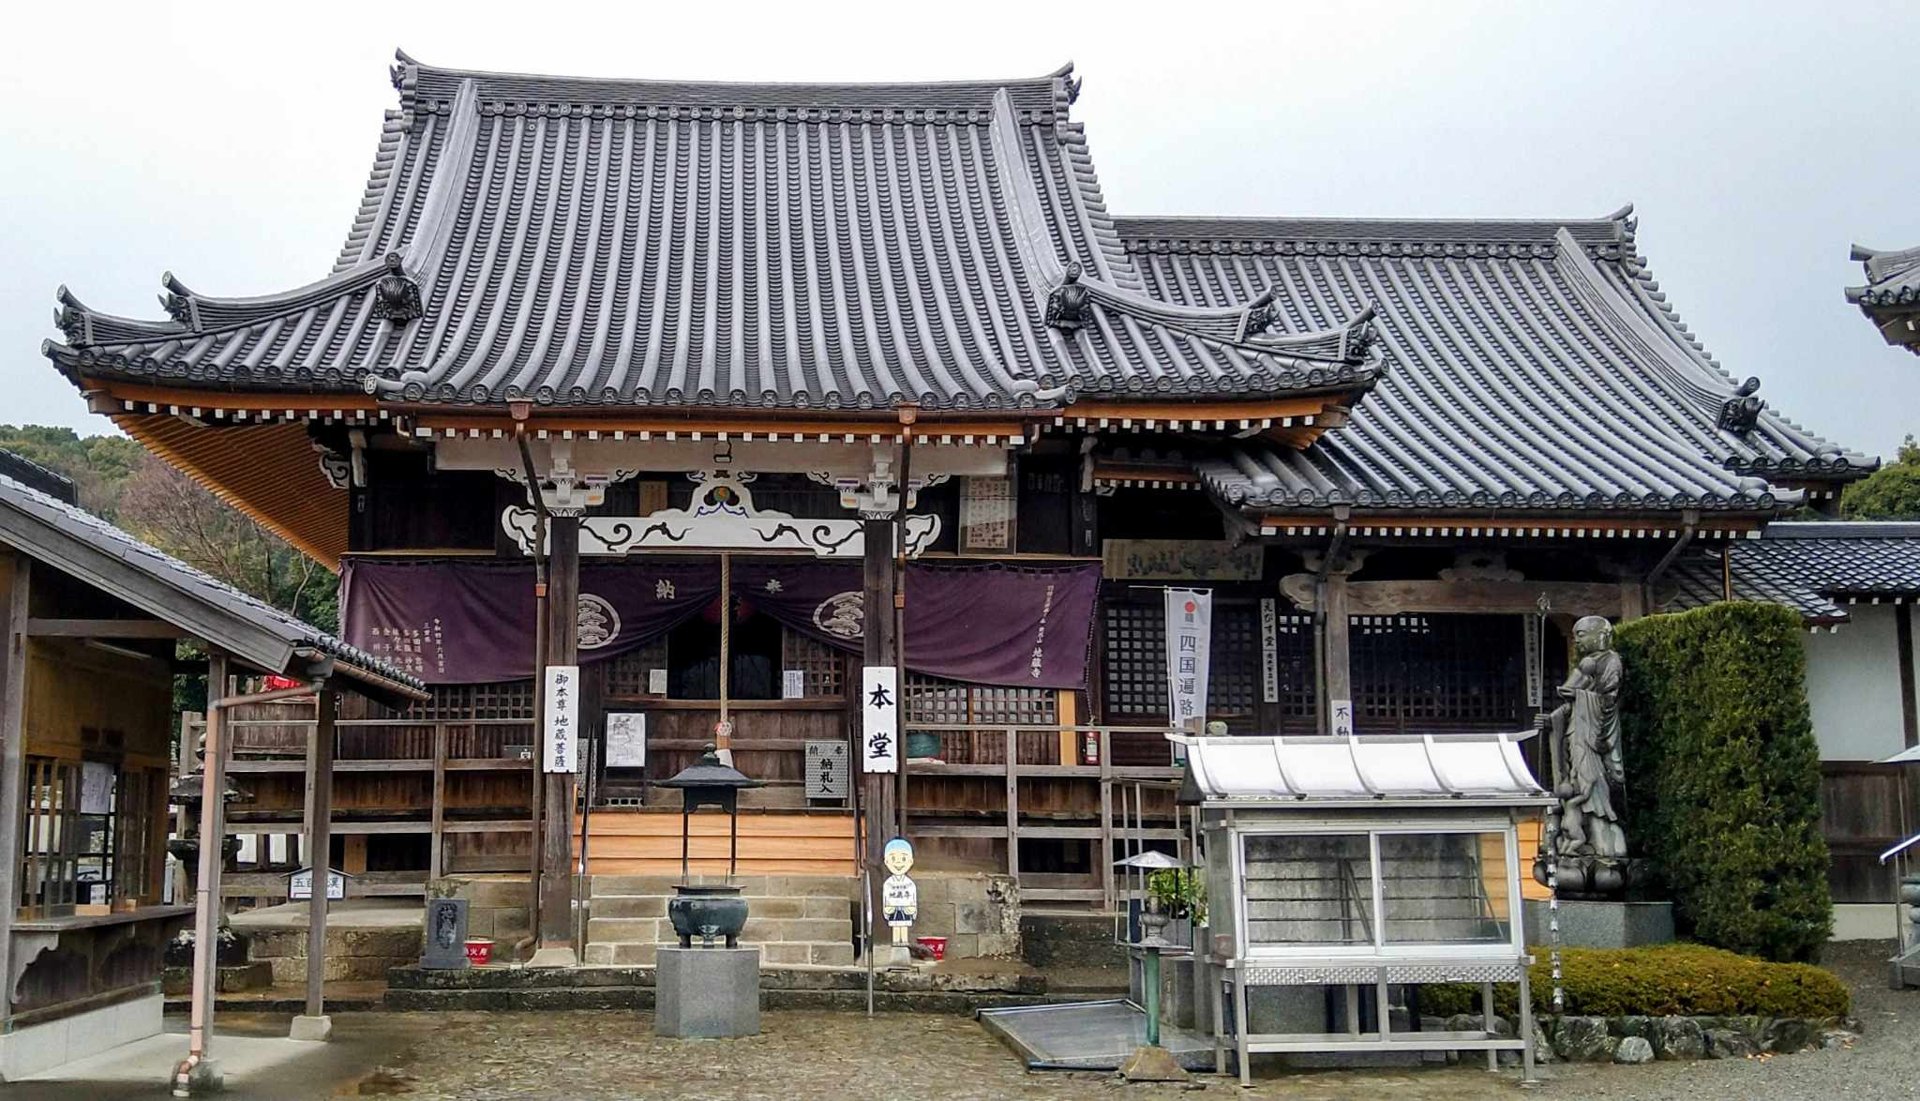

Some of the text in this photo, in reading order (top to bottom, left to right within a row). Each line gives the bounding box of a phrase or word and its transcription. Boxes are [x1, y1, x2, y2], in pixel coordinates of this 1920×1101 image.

[655, 578, 676, 600] 納
[1178, 633, 1197, 717] 四国遍路
[554, 673, 569, 768] 御本尊地蔵菩薩
[868, 682, 895, 760] 本堂
[819, 757, 834, 794] 納札入
